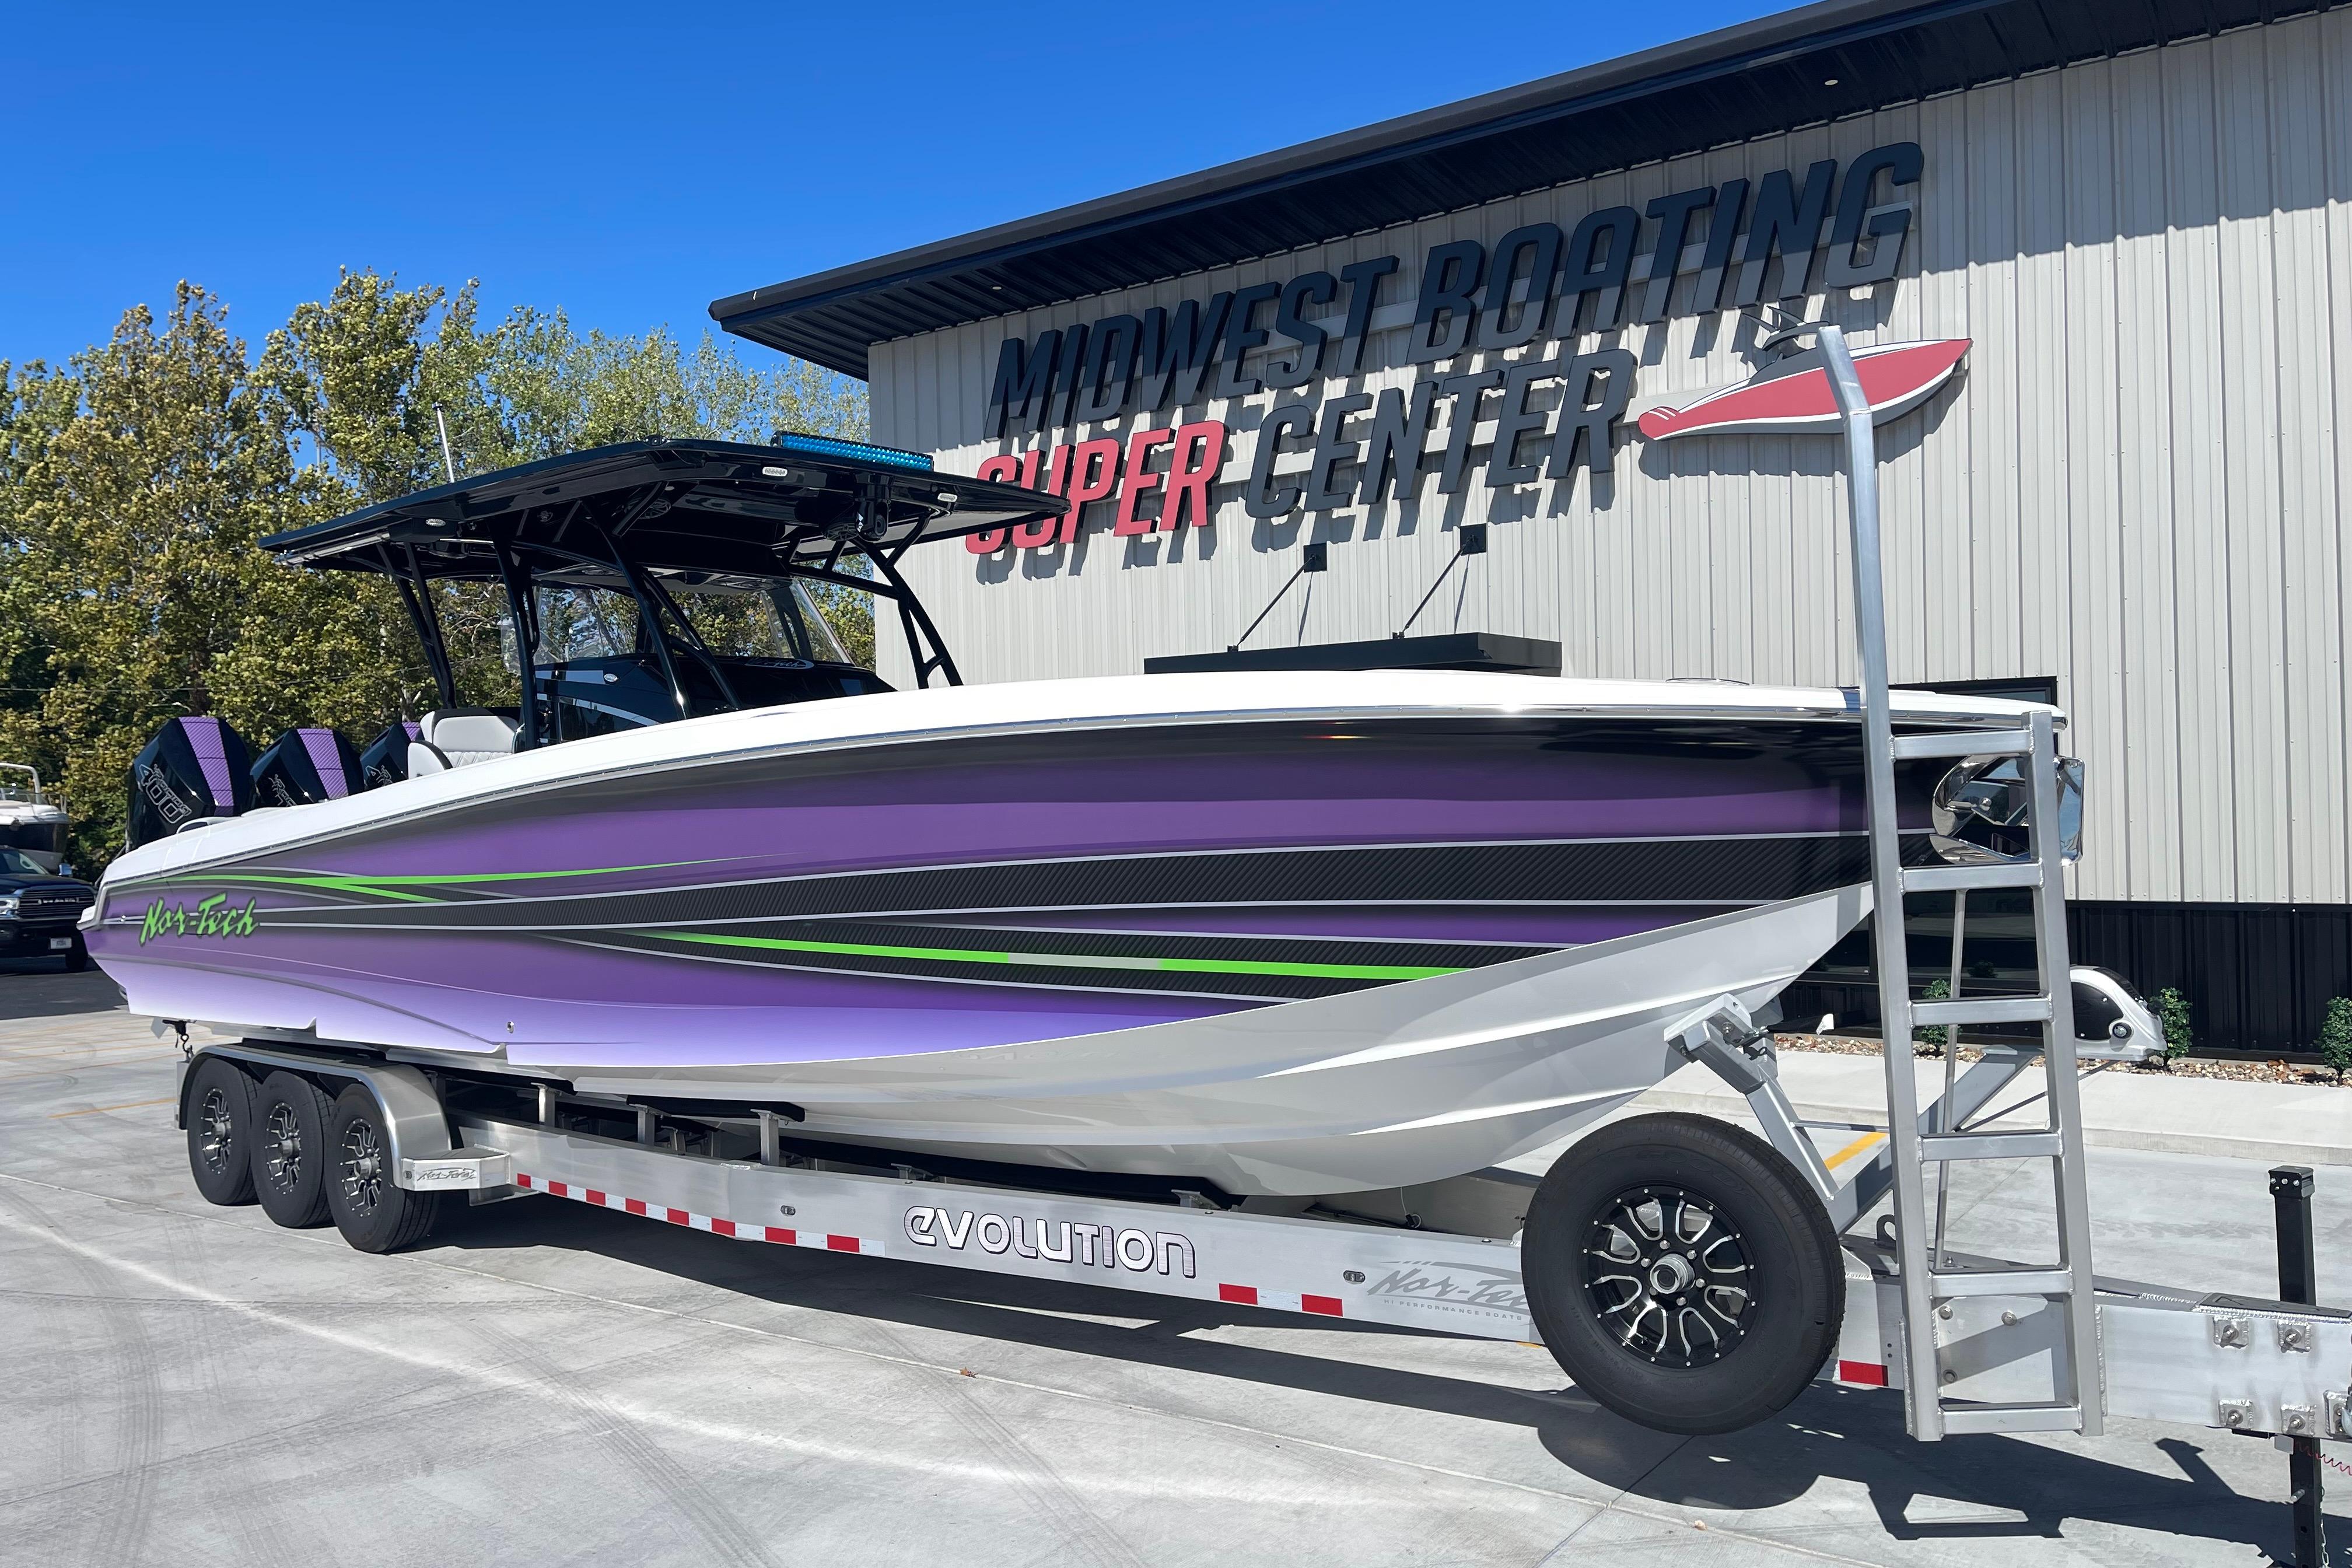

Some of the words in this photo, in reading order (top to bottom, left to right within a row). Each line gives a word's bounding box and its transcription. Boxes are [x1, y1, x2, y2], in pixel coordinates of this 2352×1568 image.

[985, 255, 1399, 442] MIDWEST
[1405, 142, 1923, 365] BOATING
[965, 420, 1228, 554] SUPER
[1245, 349, 1637, 519] CENTER
[139, 891, 259, 946] Nor-Tech
[1399, 1301, 1480, 1315] PERFORMANCE
[1485, 1311, 1522, 1321] BOATS
